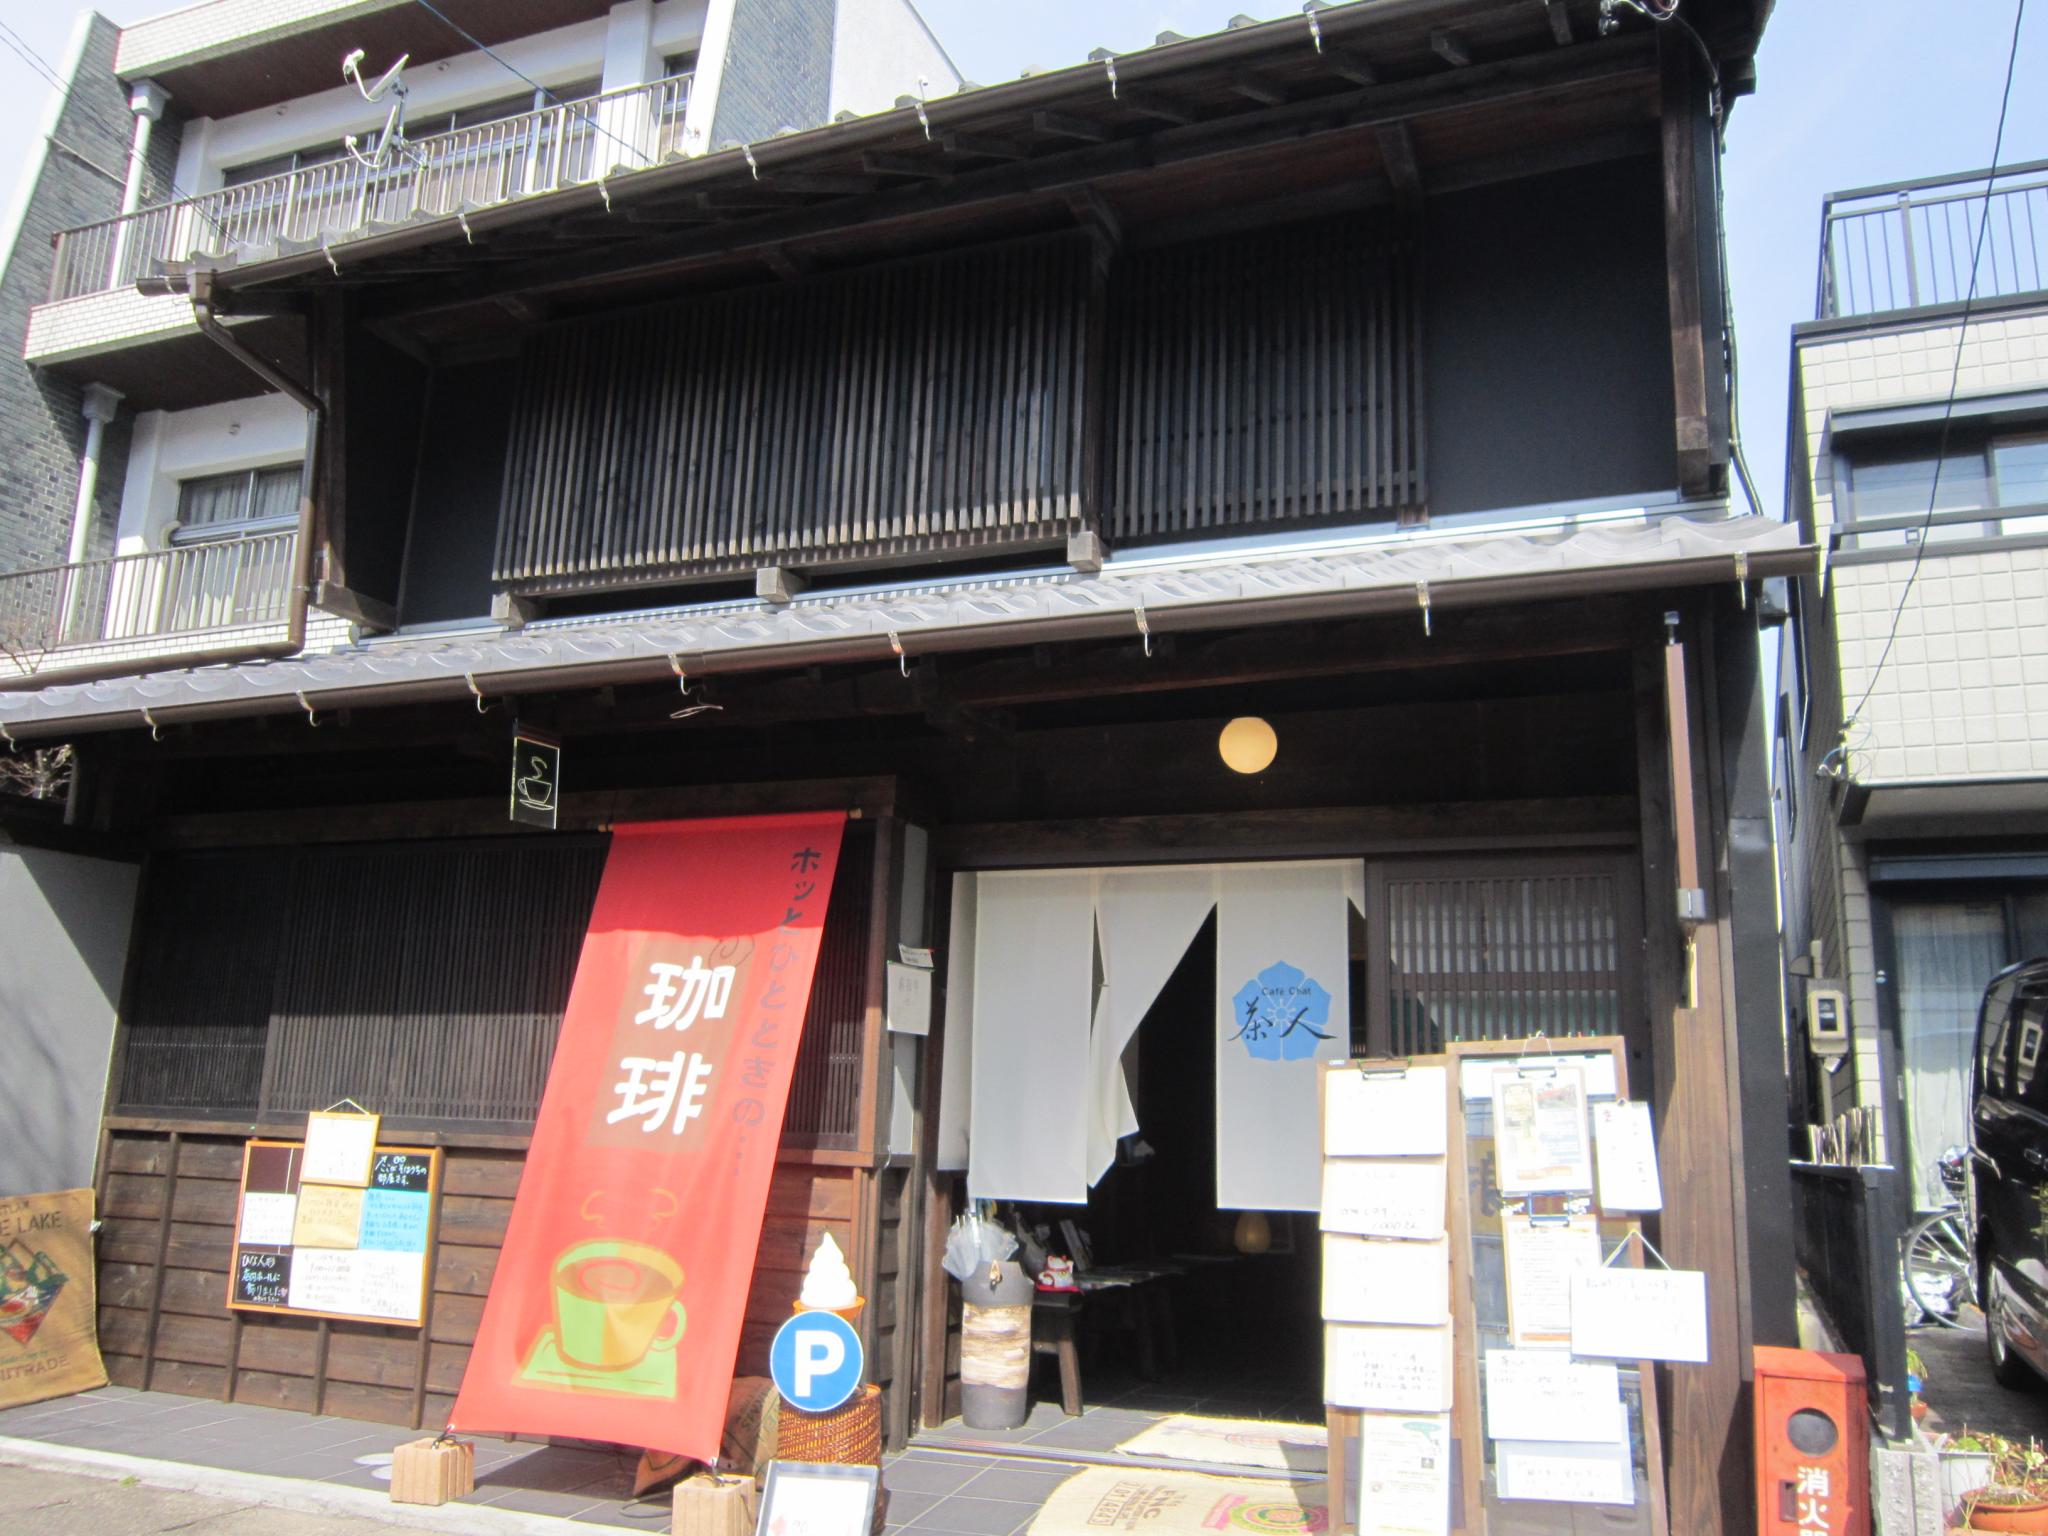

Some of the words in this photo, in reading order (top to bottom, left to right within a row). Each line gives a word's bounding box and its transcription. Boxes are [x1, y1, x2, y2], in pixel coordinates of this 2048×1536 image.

[1226, 995, 1338, 1042] 茶人
[1288, 986, 1312, 996] Chat
[606, 955, 737, 1134] 珈琲
[16, 1210, 63, 1234] LAKE
[794, 1329, 845, 1398] P
[1796, 1465, 1831, 1536] 消火
